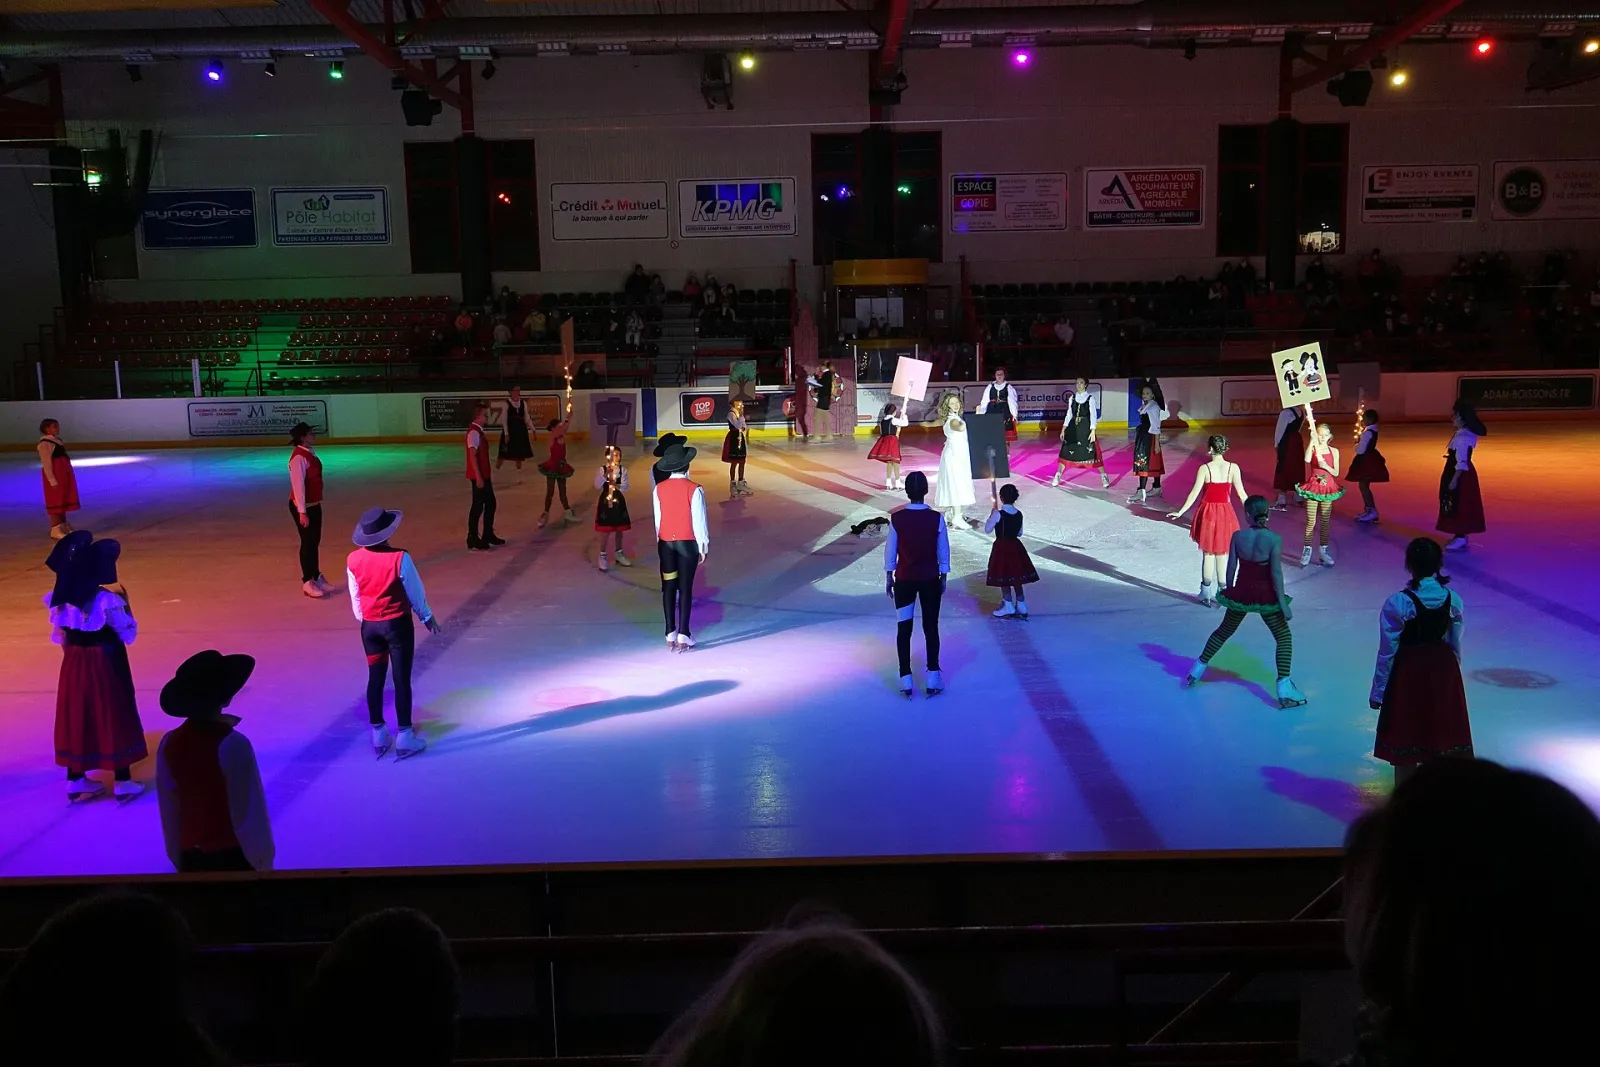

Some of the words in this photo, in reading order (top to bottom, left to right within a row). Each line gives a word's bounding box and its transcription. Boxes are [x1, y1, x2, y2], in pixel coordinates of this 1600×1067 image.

[1171, 173, 1195, 181] VOUS
[1396, 171, 1430, 179] ENJOY
[1434, 170, 1473, 178] EVENTS
[957, 181, 993, 192] ESPACE
[1135, 182, 1178, 190] SOUHAITE
[1181, 182, 1193, 190] UN
[1140, 190, 1188, 199] AGRÉABLE
[559, 200, 599, 211] Crédit
[616, 199, 661, 210] Mutuel
[960, 198, 989, 208] COPIE
[144, 207, 252, 220] synerglace
[692, 198, 777, 222] KPMG
[286, 211, 318, 224] Pôle
[322, 210, 377, 223] Habitat
[581, 214, 608, 222] banque
[615, 214, 626, 222] qui
[627, 214, 649, 222] parler
[1017, 394, 1061, 402] E.Leclerc
[695, 401, 711, 410] TOP
